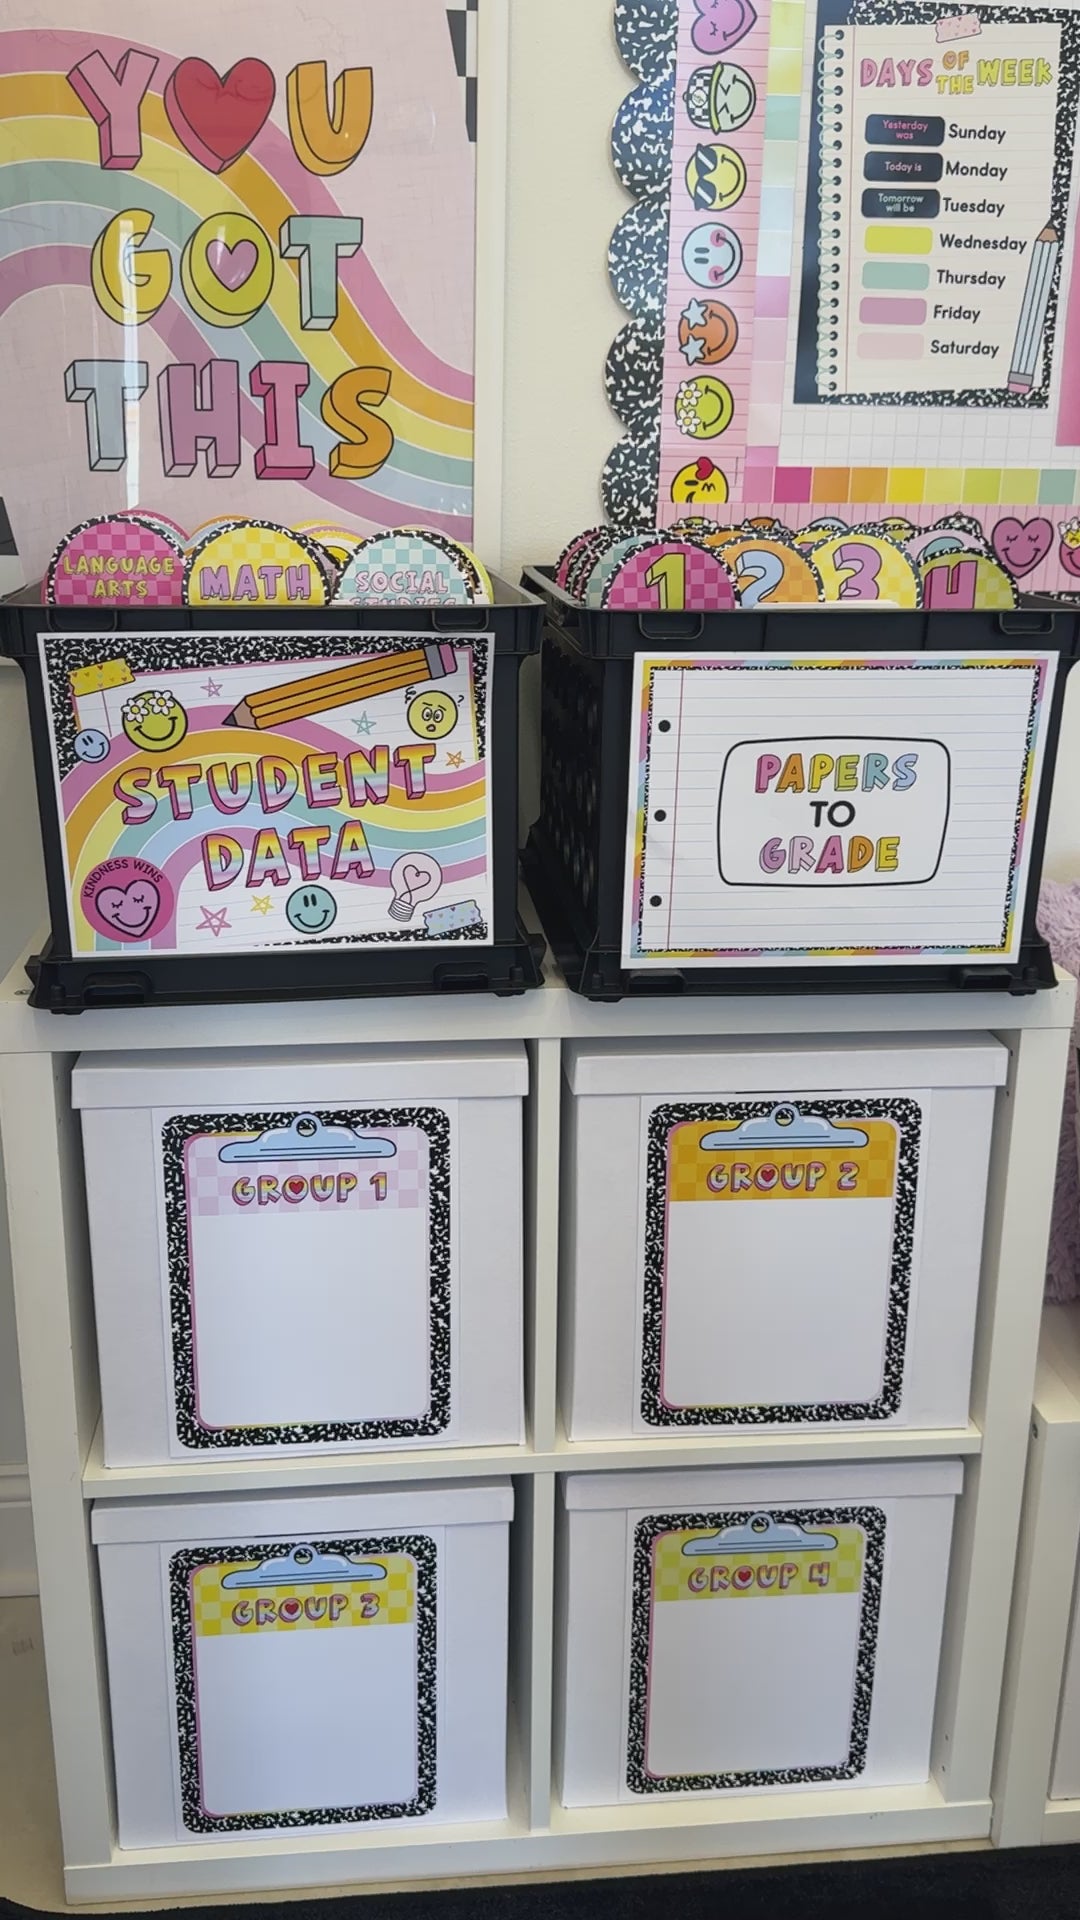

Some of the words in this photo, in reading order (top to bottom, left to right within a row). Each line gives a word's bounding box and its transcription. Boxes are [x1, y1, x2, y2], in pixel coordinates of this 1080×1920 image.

[860, 57, 934, 88] DAYS
[942, 50, 970, 71] OF
[976, 57, 1053, 87] WEEK
[936, 74, 975, 95] THE
[882, 119, 929, 131] Yesterday
[896, 132, 914, 140] was
[948, 123, 1006, 144] Sunday
[885, 161, 912, 173] Today
[914, 162, 922, 171] is
[945, 161, 1008, 181] Monday
[878, 192, 924, 203] Tomorrow
[886, 204, 902, 213] will
[903, 204, 915, 213] be
[942, 197, 1005, 217] Tuesday
[939, 233, 1027, 254] Wednesday
[90, 208, 363, 331] GOT
[936, 269, 1006, 289] Thursday
[933, 304, 981, 324] Friday
[930, 339, 1000, 359] Saturday
[64, 359, 394, 480] THIS
[63, 555, 175, 575] LANGUAGE
[735, 549, 784, 608] 2
[832, 542, 882, 600] 3
[92, 579, 149, 599] ARTS
[200, 564, 311, 601] MATH
[354, 570, 448, 594] SOCIAL
[644, 552, 686, 609] 1
[922, 560, 978, 609] 4
[114, 743, 436, 825] STUDENT
[755, 753, 918, 794] PAPERS
[809, 800, 856, 828] TO
[201, 820, 376, 892] DATA
[759, 835, 901, 874] GRADE
[83, 859, 129, 898] KINDNESS
[133, 860, 164, 883] WINS
[231, 1172, 358, 1206] GROUP
[369, 1171, 388, 1201] 1
[706, 1161, 827, 1193] GROUP
[837, 1161, 860, 1190] 2
[688, 1563, 799, 1592] GROUP
[808, 1561, 831, 1587] 4
[231, 1593, 349, 1627] GROUP
[360, 1592, 381, 1619] 3
